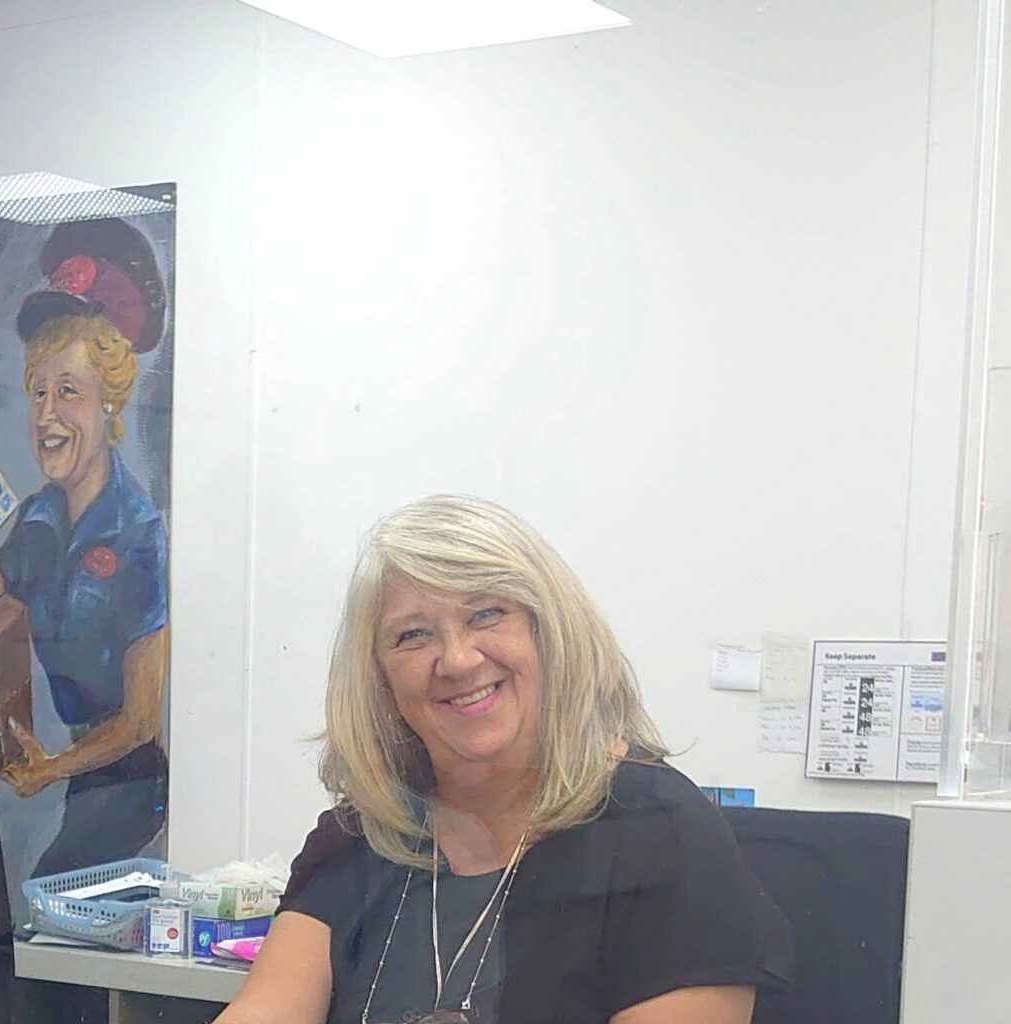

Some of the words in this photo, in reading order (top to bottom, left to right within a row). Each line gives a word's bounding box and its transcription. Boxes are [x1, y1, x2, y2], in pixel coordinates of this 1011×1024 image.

[825, 653, 842, 661] Keep
[844, 653, 876, 661] Separate
[182, 887, 204, 901] Vinyl
[241, 887, 264, 904] Vinyl
